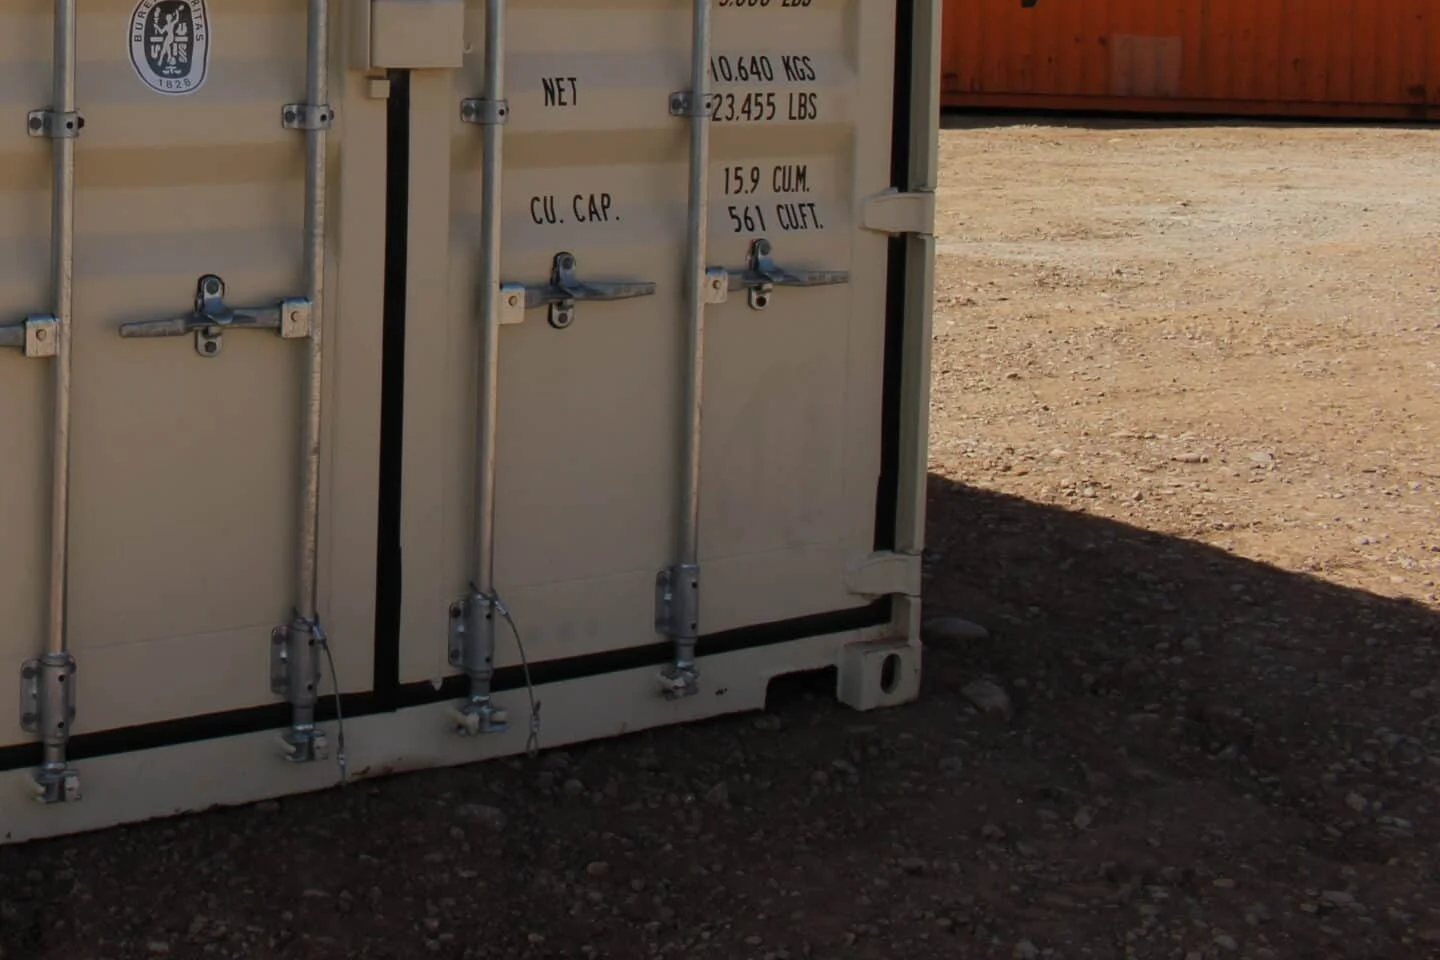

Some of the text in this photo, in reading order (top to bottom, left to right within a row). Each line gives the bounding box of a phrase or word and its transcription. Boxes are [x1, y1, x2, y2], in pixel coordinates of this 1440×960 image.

[781, 56, 816, 82] KGS
[541, 77, 577, 107] NET
[788, 92, 817, 120] LBS
[723, 166, 760, 194] 15.9
[530, 192, 621, 224] CU. CAP.
[727, 206, 766, 232] 561
